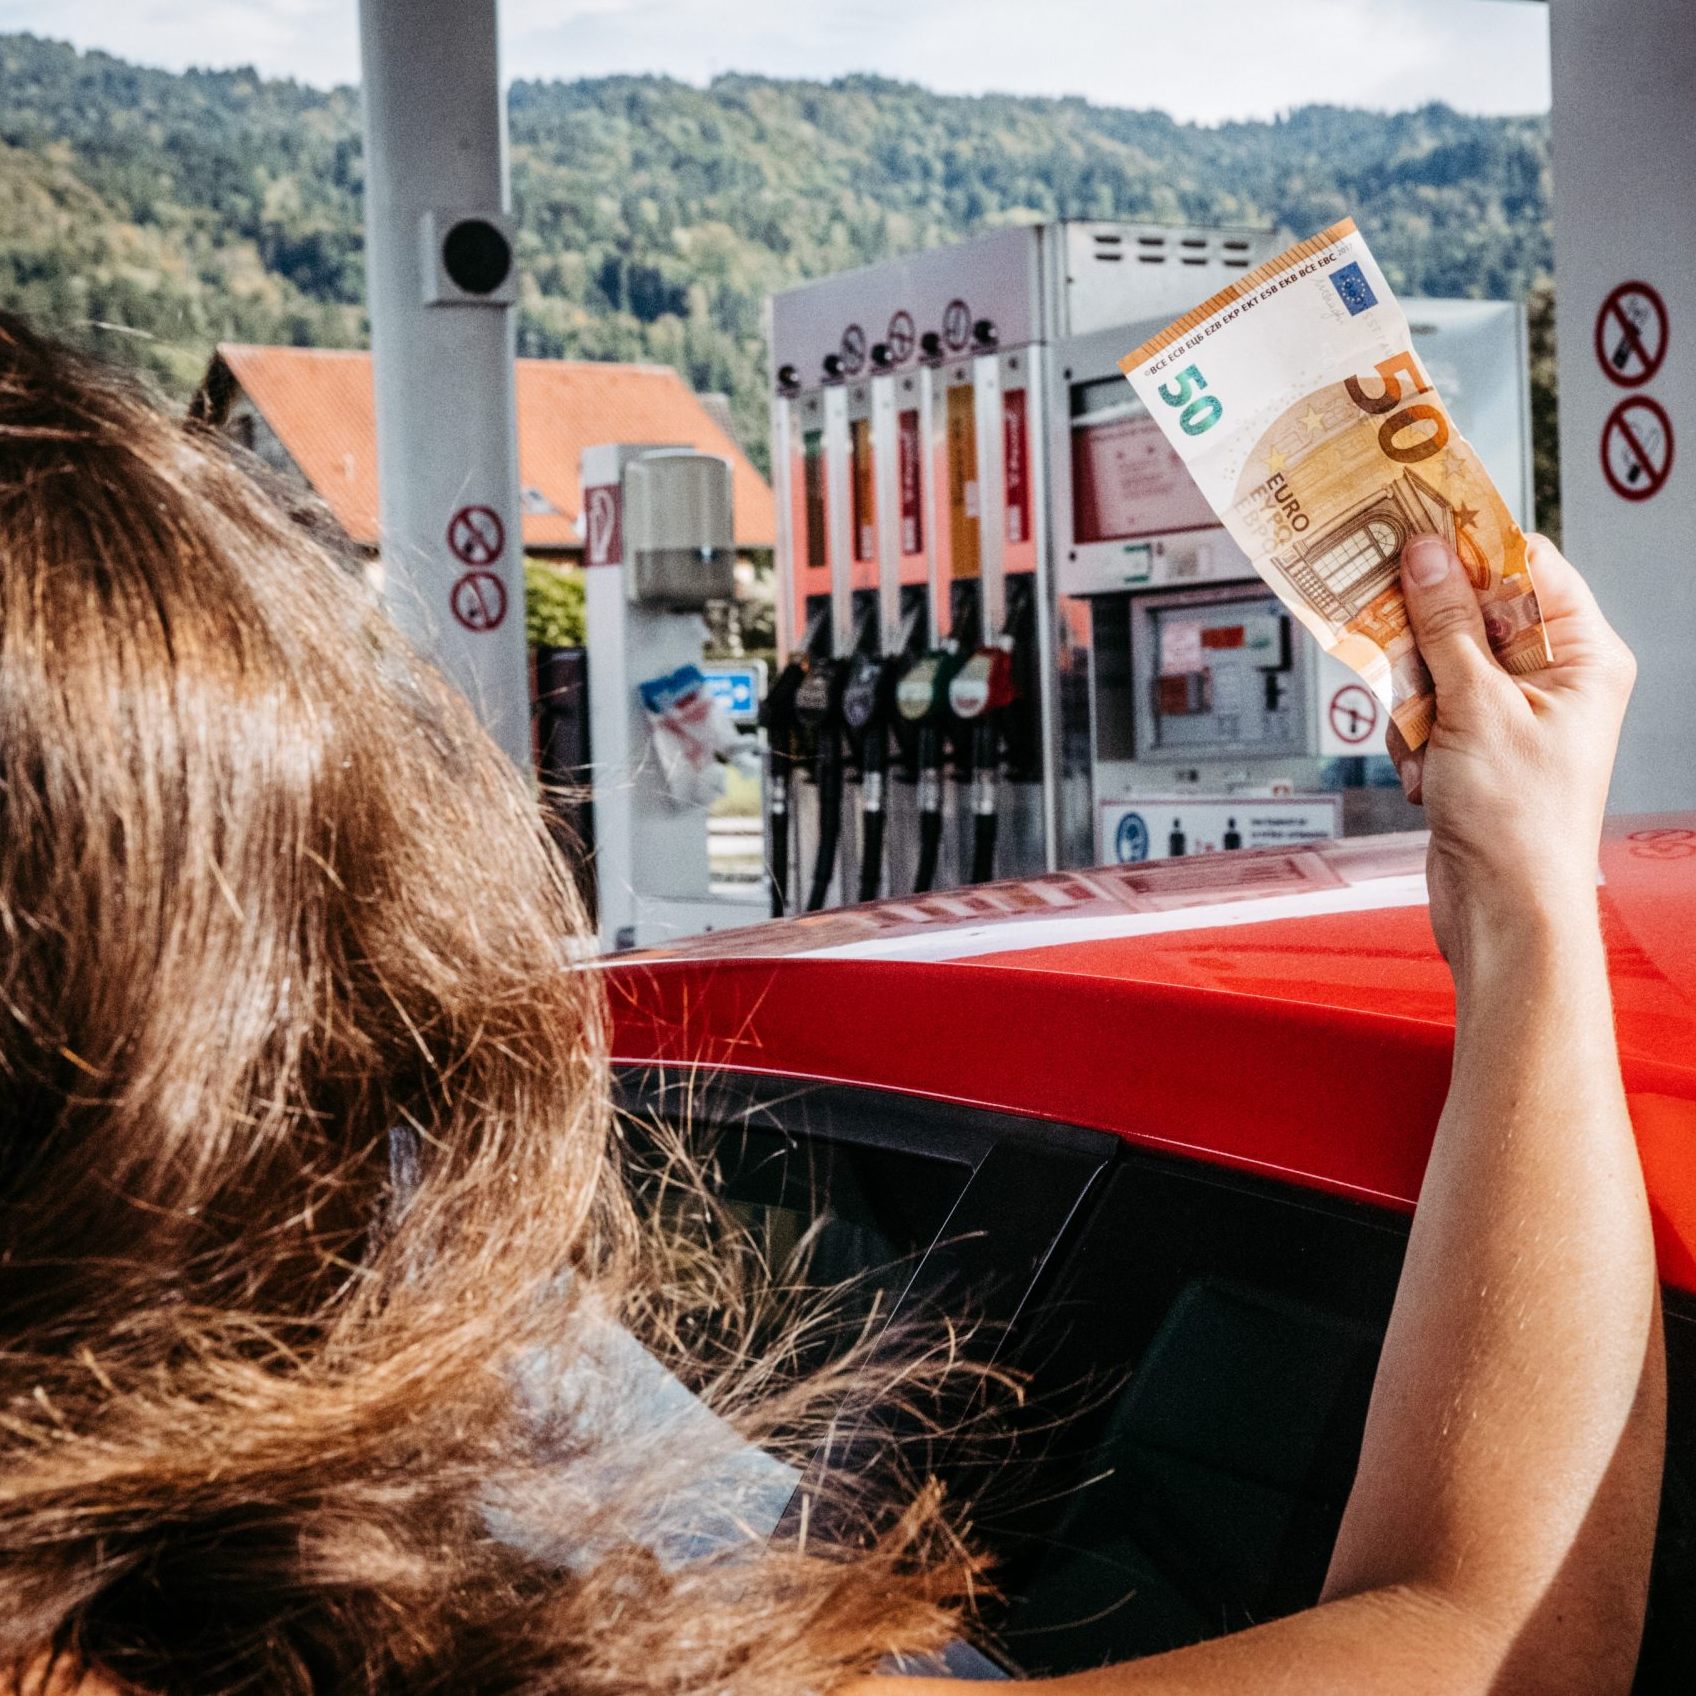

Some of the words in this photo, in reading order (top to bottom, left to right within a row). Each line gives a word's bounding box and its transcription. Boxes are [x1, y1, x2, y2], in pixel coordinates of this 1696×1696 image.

[1167, 346, 1186, 363] ECB
[1204, 321, 1222, 337] EZB
[1222, 308, 1240, 325] EKP
[1260, 285, 1279, 301] ESB
[1279, 274, 1298, 289] EKB
[1317, 252, 1337, 268] EBC
[1158, 363, 1223, 436] 50
[1343, 350, 1450, 464] 50
[1266, 472, 1310, 532] EURO
